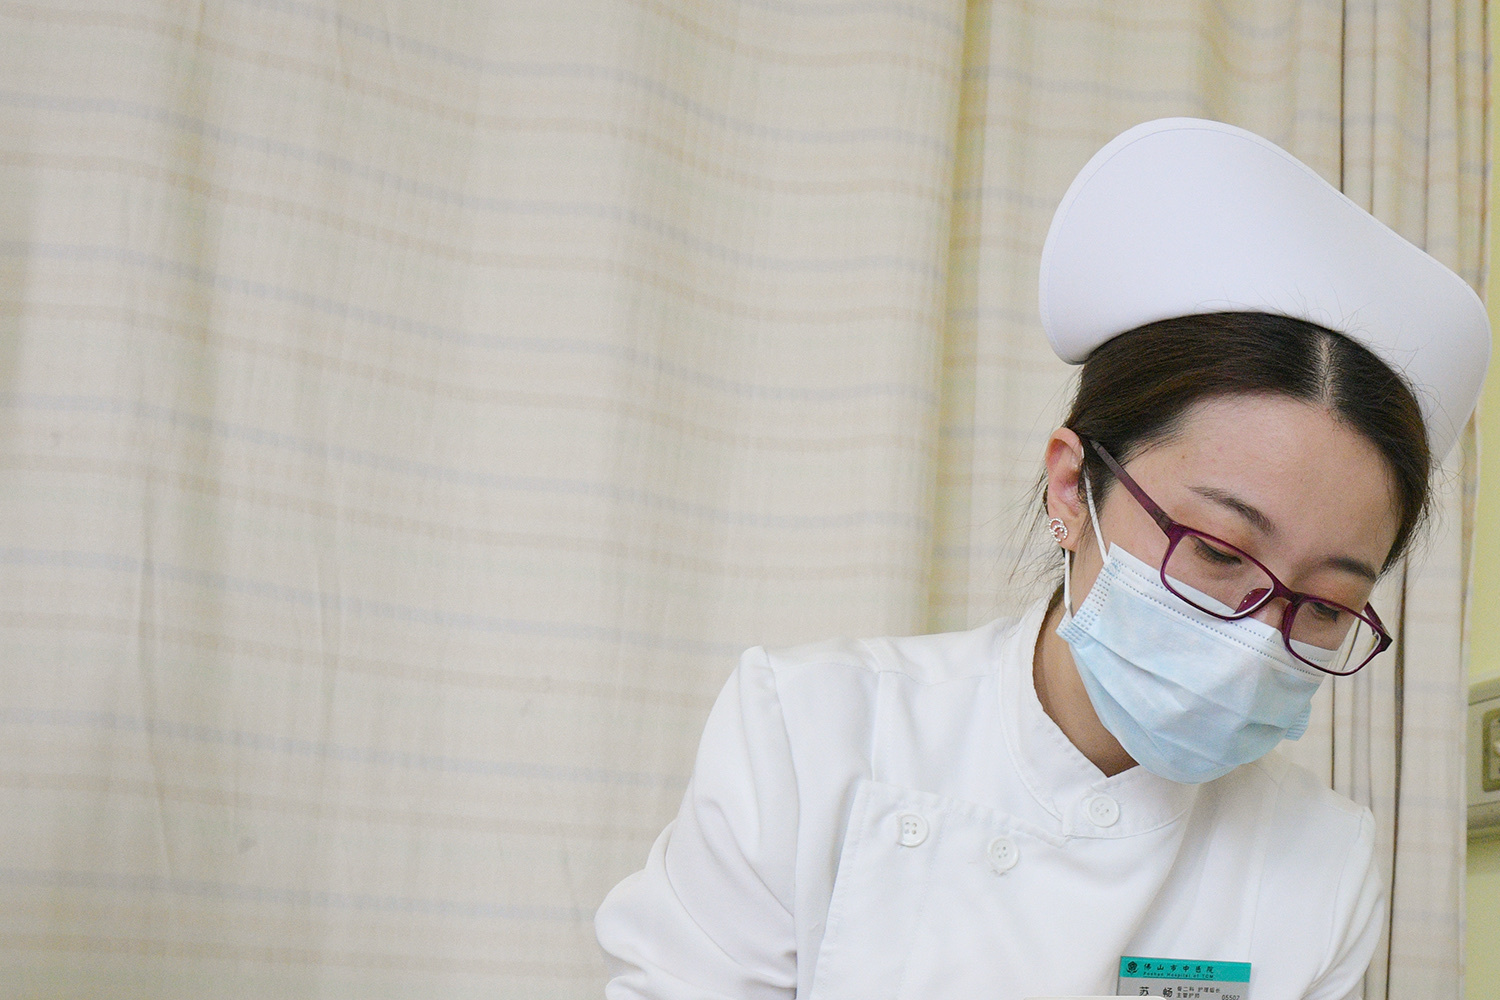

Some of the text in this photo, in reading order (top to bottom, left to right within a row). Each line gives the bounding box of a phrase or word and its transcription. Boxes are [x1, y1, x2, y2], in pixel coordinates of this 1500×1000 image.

[1143, 963, 1214, 974] 佛山市中医院
